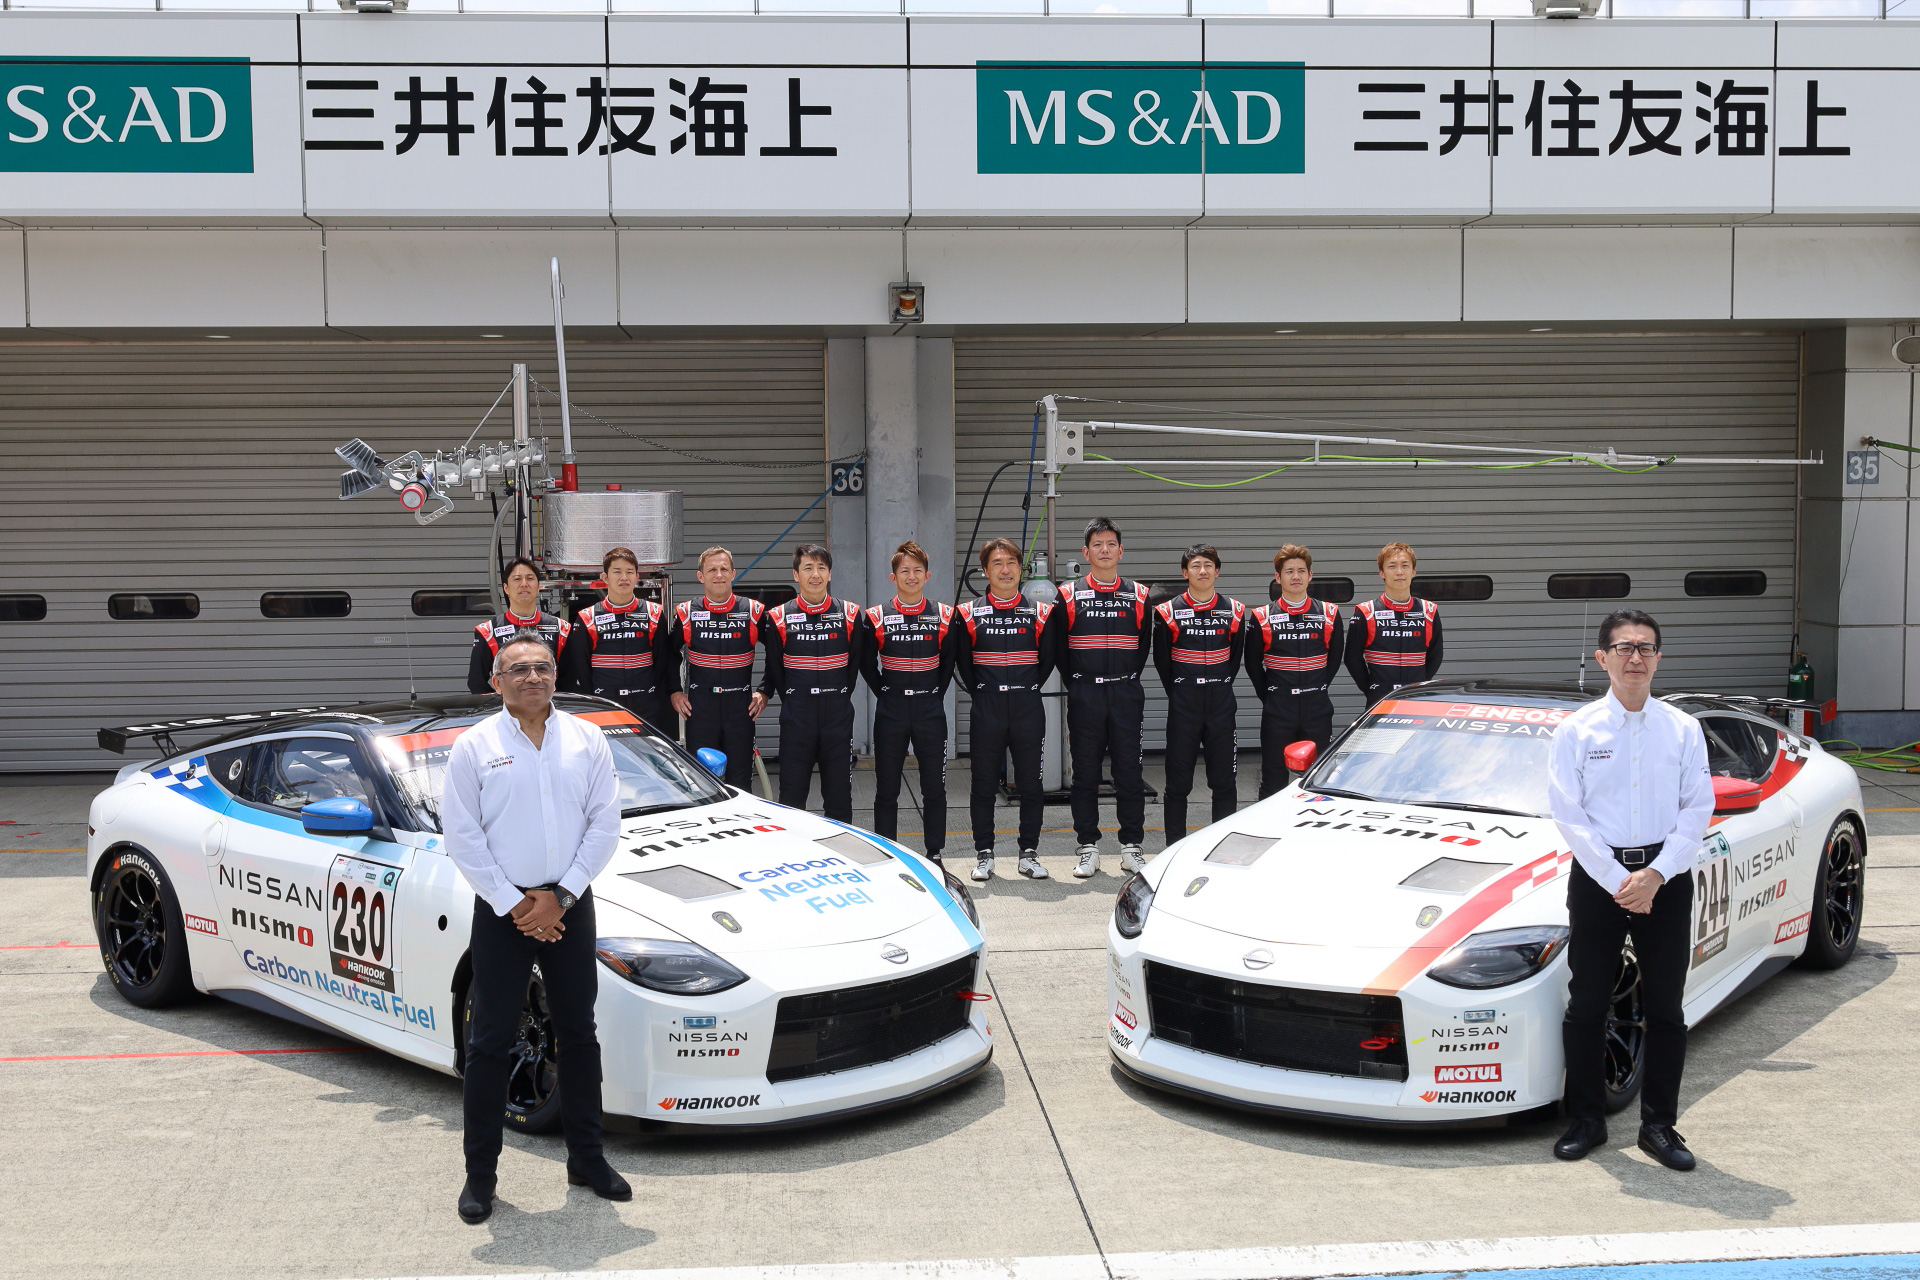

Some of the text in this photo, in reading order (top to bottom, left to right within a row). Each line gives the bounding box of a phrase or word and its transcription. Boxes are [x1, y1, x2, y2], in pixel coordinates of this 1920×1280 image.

[304, 75, 838, 158] 三井住友海上
[1003, 88, 1282, 147] MS&AD
[1354, 79, 1851, 158] 三井住友海上
[1849, 456, 1878, 480] 35
[833, 468, 863, 492] 36
[1081, 600, 1131, 608] NISSAN
[981, 617, 1031, 625] NISSAN
[1086, 610, 1127, 618] nismo
[597, 620, 649, 632] NISSAN
[695, 620, 746, 629] NISSAN
[791, 621, 842, 631] NISSAN
[886, 623, 938, 632] NISSAN
[1180, 618, 1229, 627] NISSAN
[1272, 622, 1323, 631] NISSAN
[603, 631, 644, 640] nismo
[700, 631, 742, 639] nismo
[796, 633, 838, 641] nismo
[891, 634, 933, 642] nismo
[1186, 628, 1225, 636] nismo
[1376, 717, 1425, 725] nismo
[1468, 706, 1565, 724] ENEOS
[1435, 718, 1556, 737] NISSAN
[415, 750, 451, 761] nis
[487, 755, 515, 766] NISSAN
[1296, 808, 1529, 840] NISSAN
[629, 824, 787, 858] nismo
[1293, 820, 1482, 847] nismo
[1734, 836, 1795, 887] NISSAN
[738, 857, 847, 883] Carbon
[383, 871, 396, 887] Q
[758, 868, 872, 903] Neutral
[219, 864, 323, 912] NISSAN
[805, 887, 875, 915] Fuel
[1697, 858, 1729, 942] 244
[1738, 878, 1787, 922] nismo
[186, 915, 218, 934] MOTUL
[231, 906, 314, 948] nismo
[332, 881, 386, 962] 230
[1776, 914, 1809, 941] MOTUL
[356, 973, 386, 987] driving emotion
[243, 949, 436, 1031] Carbon Neutral Fuel
[669, 1031, 748, 1043] NISSAN
[1431, 1025, 1508, 1038] NISSAN
[677, 1048, 740, 1058] nismo
[1438, 1041, 1500, 1053] nismo
[1437, 1065, 1499, 1082] MOTUL
